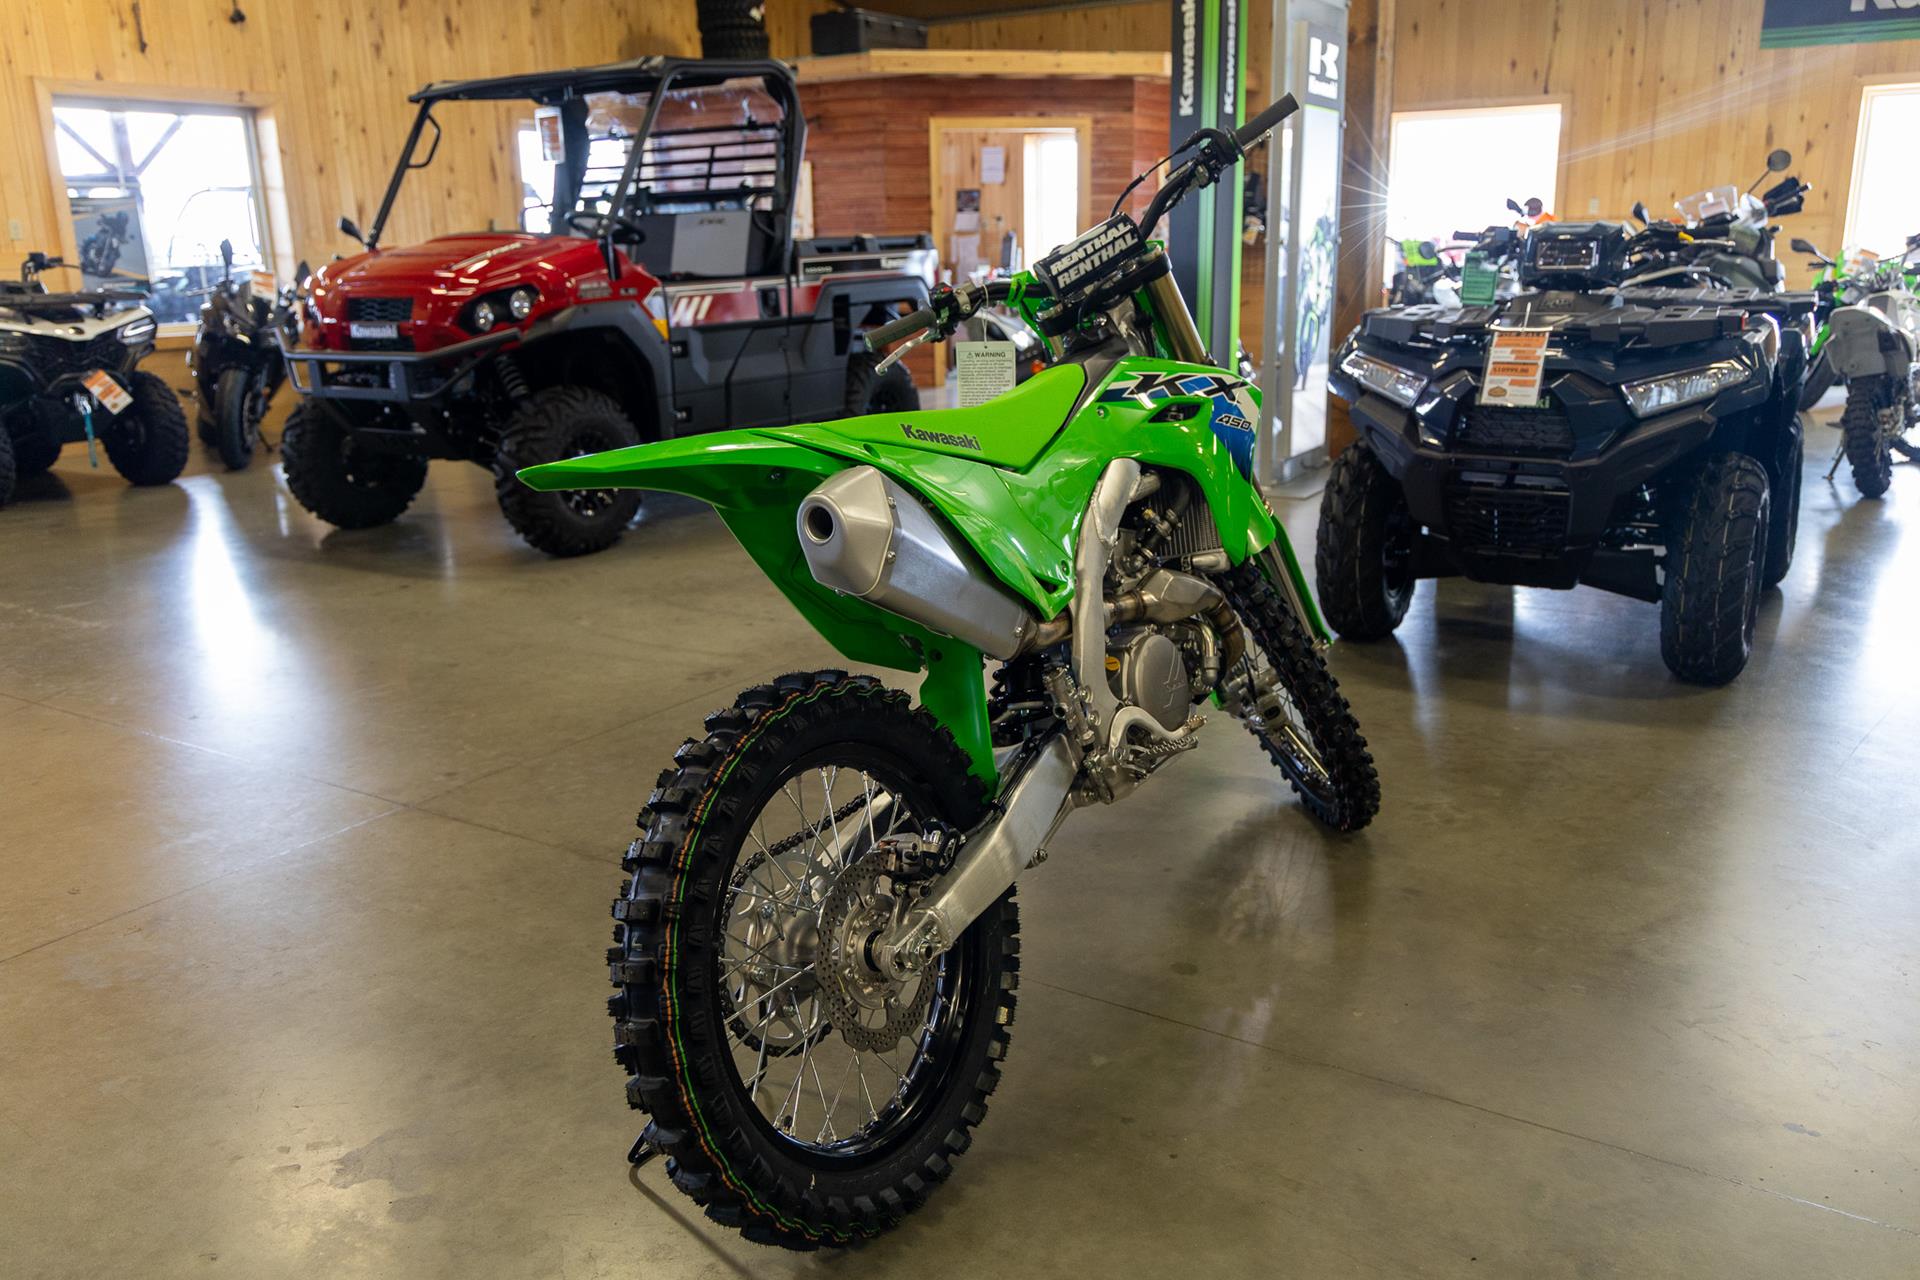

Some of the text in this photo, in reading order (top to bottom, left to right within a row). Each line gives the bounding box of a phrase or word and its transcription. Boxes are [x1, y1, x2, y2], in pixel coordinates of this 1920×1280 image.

[1049, 222, 1133, 277] RENTHAL
[1057, 233, 1139, 289] RENTHAL
[974, 351, 1006, 359] WARNING
[1122, 371, 1251, 405] KX
[900, 423, 982, 451] Kawasaki
[1215, 413, 1253, 432] 450
